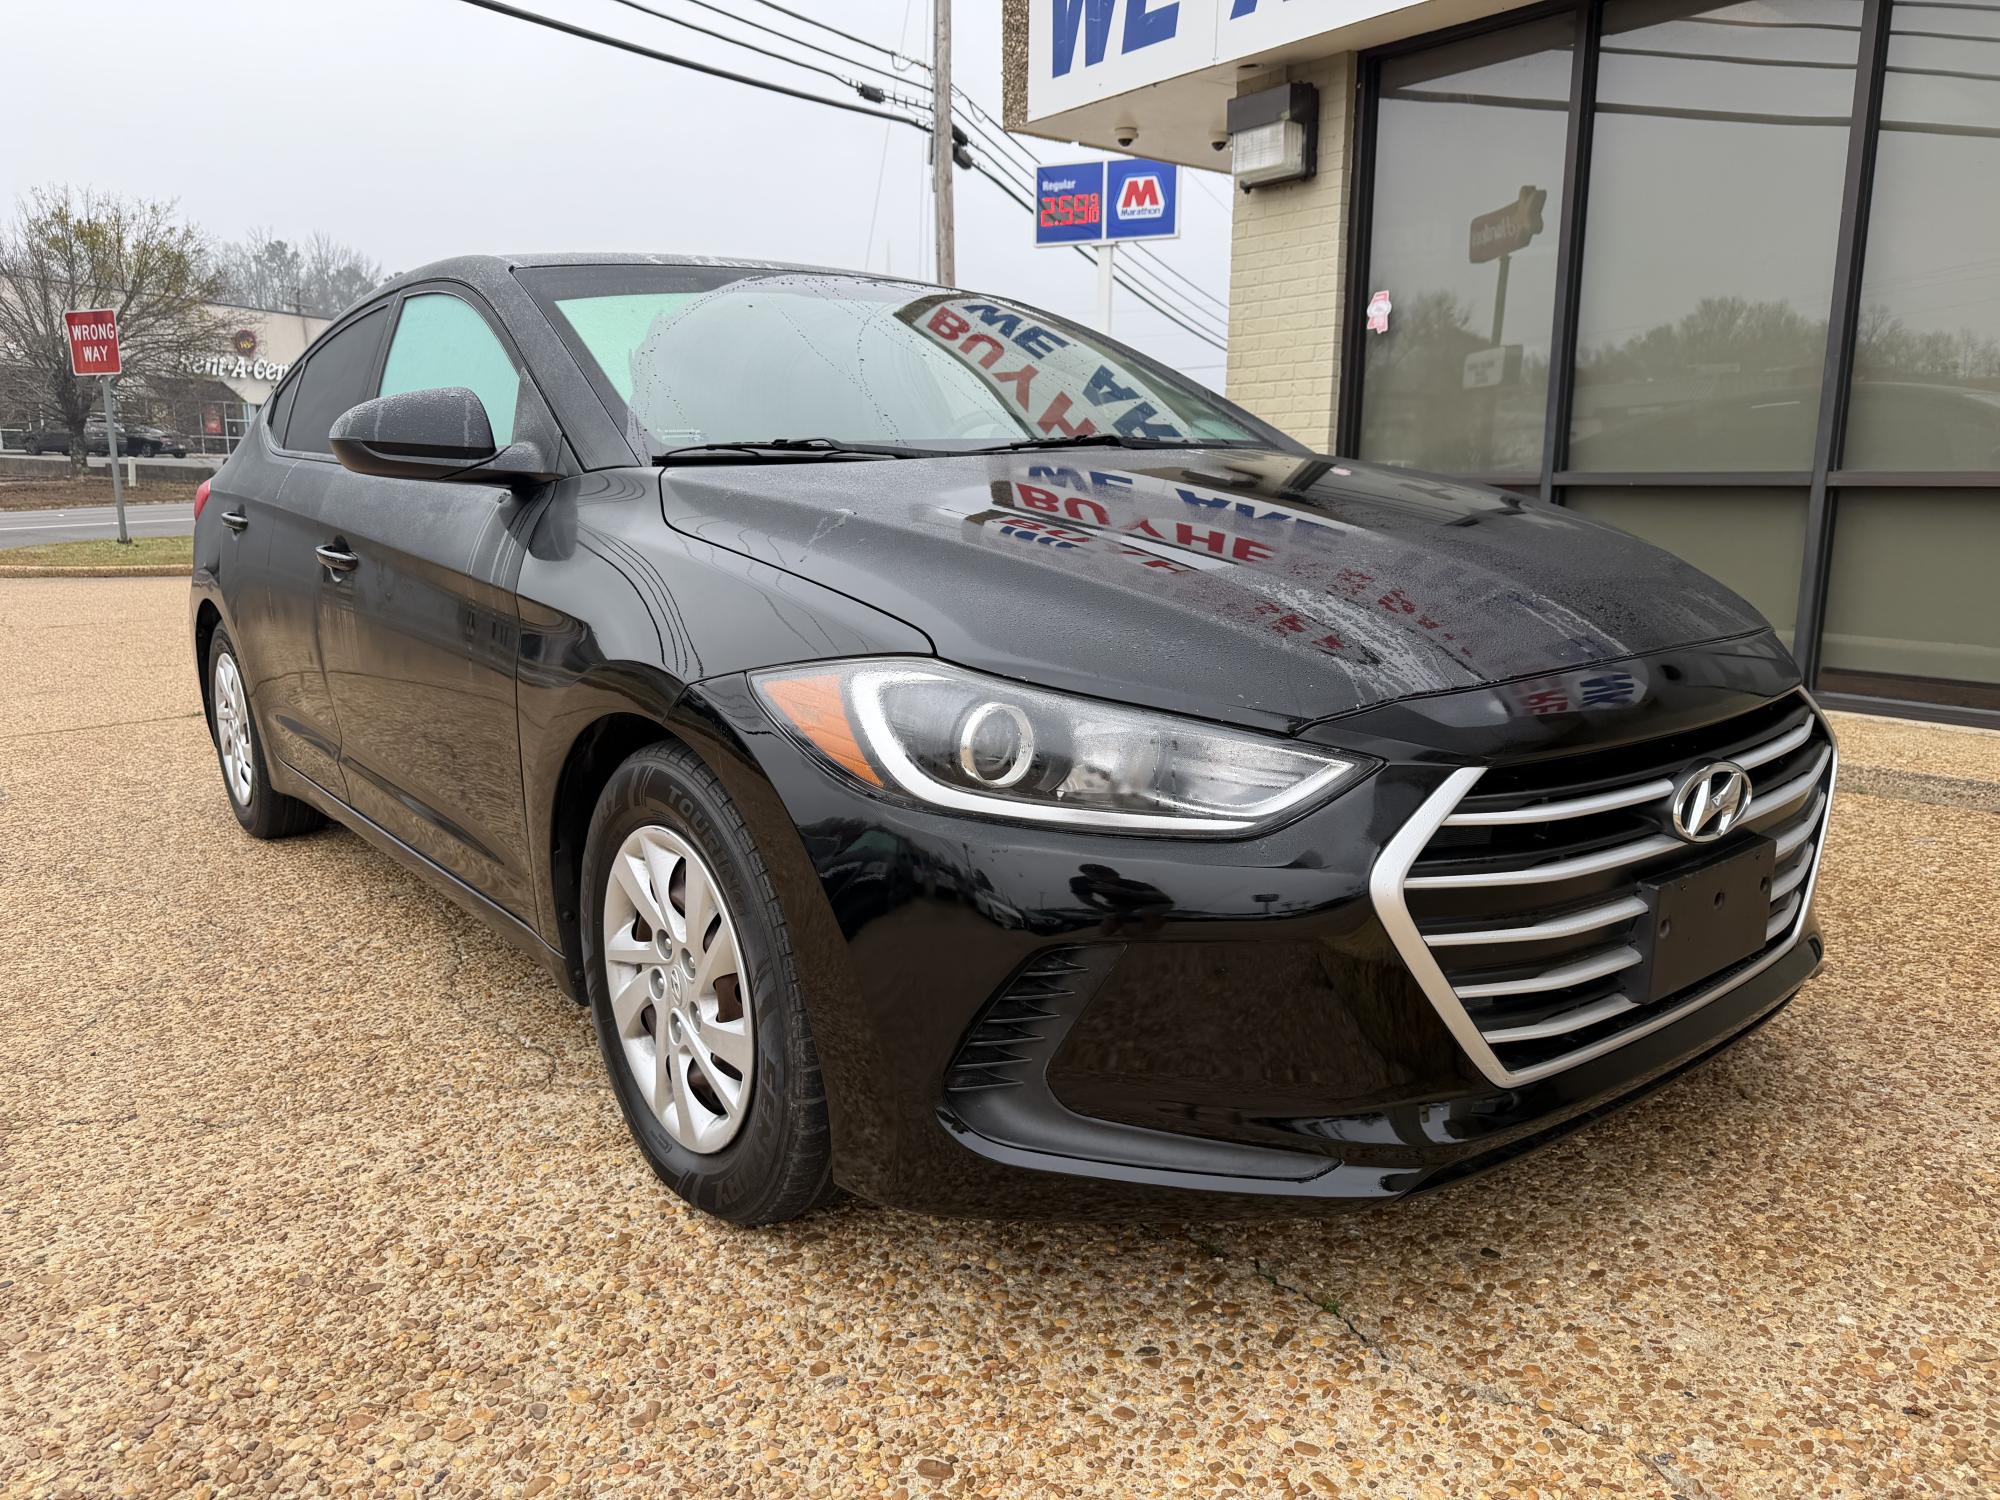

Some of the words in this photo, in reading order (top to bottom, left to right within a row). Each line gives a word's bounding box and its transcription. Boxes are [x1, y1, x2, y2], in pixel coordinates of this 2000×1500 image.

[1042, 179, 1076, 192] Regular
[1120, 208, 1161, 216] Marathon
[71, 323, 114, 341] WRONG
[83, 345, 108, 362] WAY
[667, 785, 746, 916] TOURING
